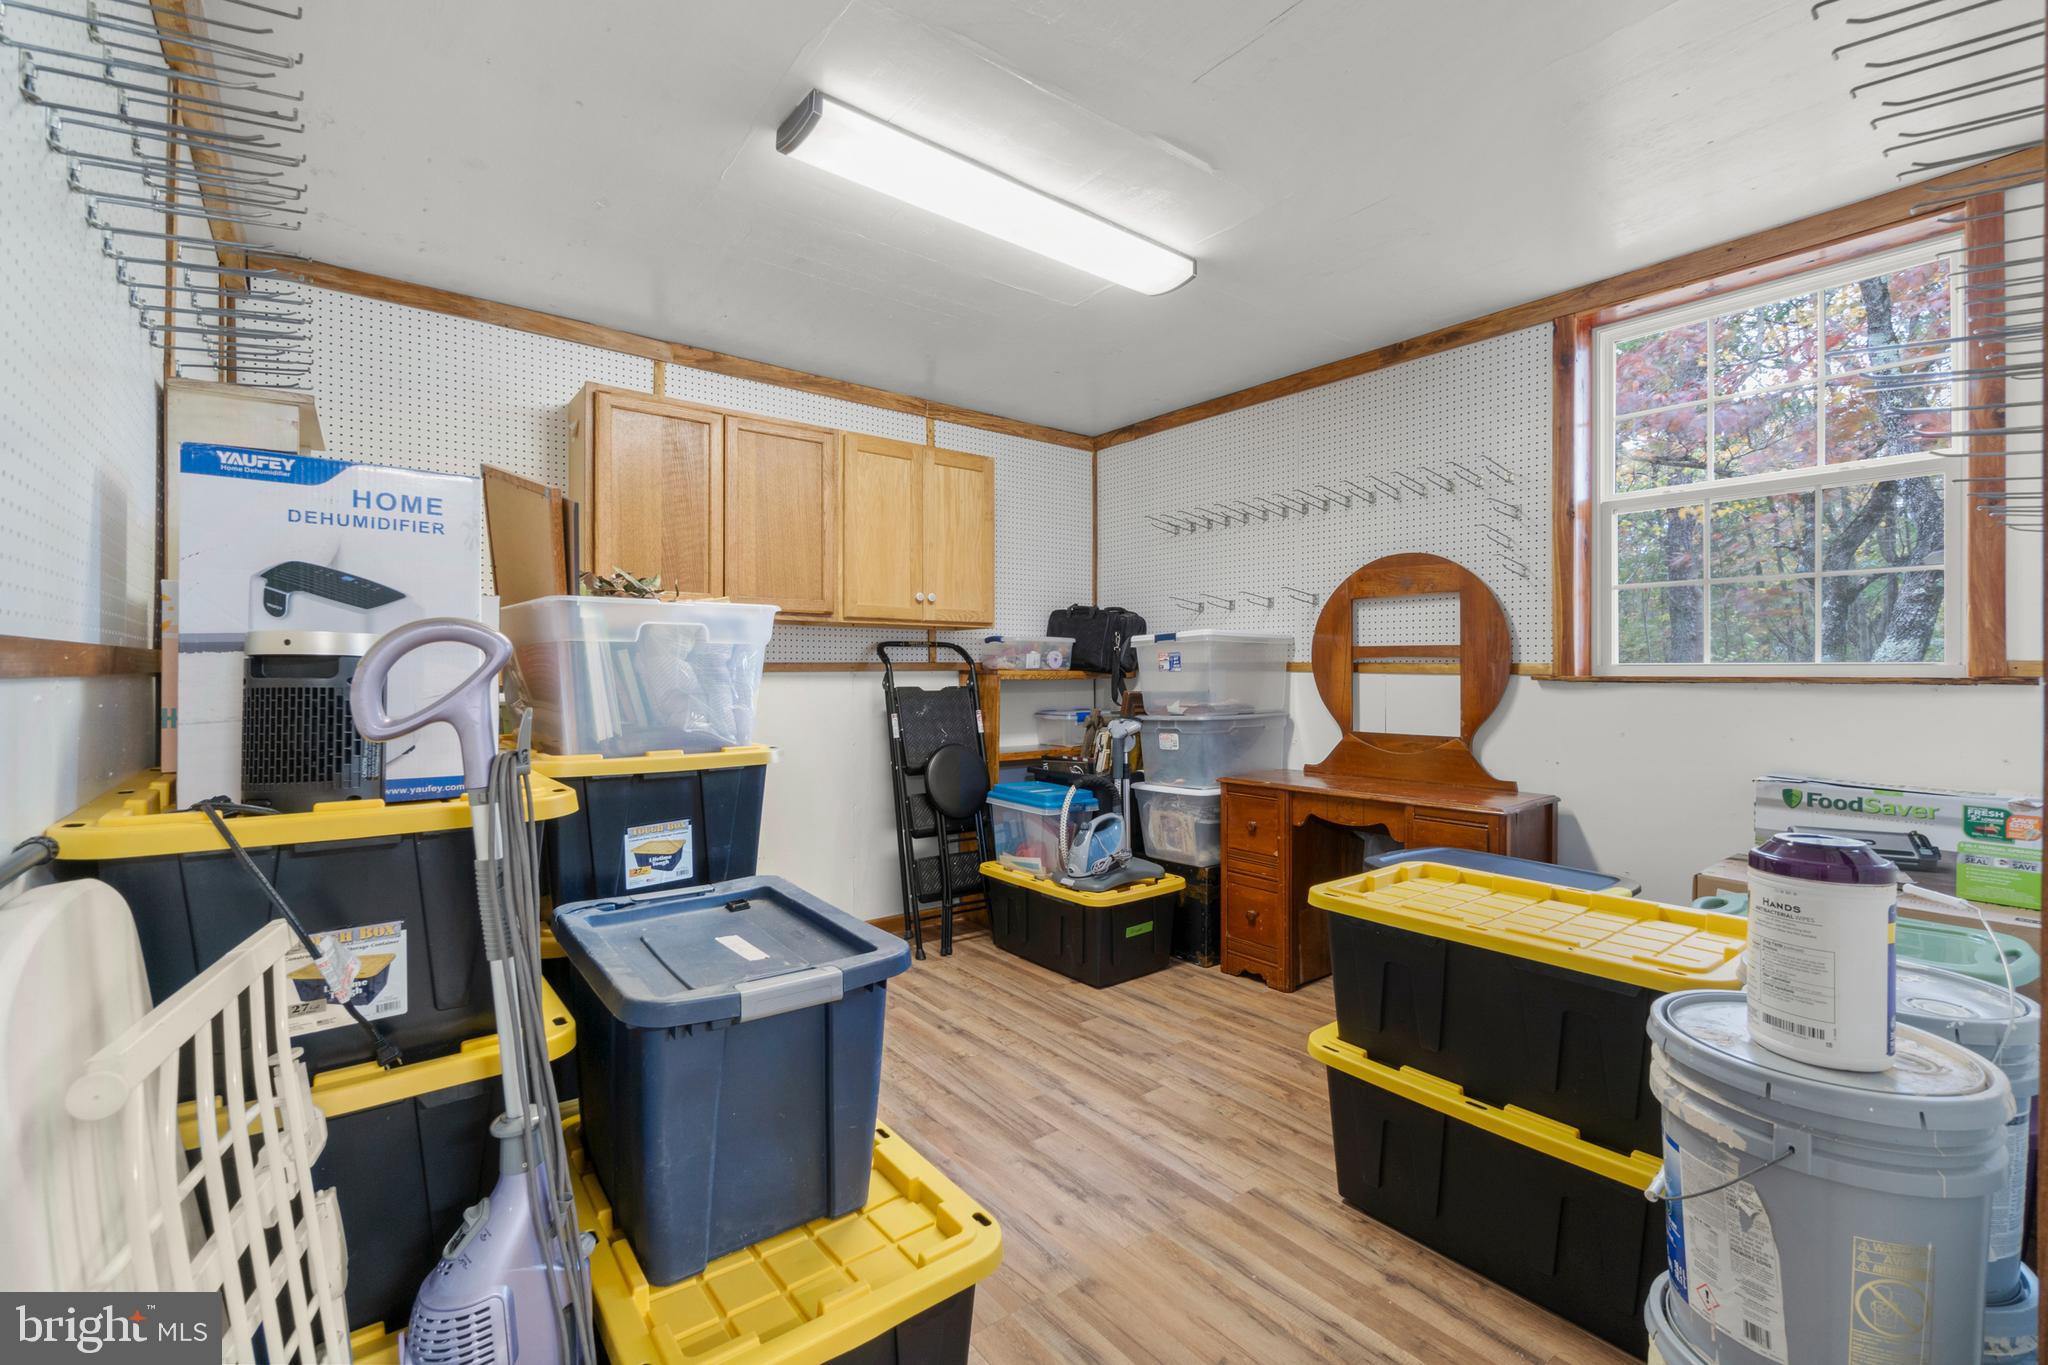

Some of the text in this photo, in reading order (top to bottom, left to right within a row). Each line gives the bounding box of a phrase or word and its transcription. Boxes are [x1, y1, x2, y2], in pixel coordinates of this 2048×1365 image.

[216, 450, 296, 471] YAUFEY
[220, 464, 291, 477] Home Dehumidifier
[352, 489, 444, 516] HOME
[287, 509, 445, 535] DEHUMIDIFIER
[1806, 792, 1941, 820] FoodSaver
[1965, 857, 1988, 866] SEAL
[2012, 863, 2037, 872] SAVE
[291, 1003, 310, 1014] 27
